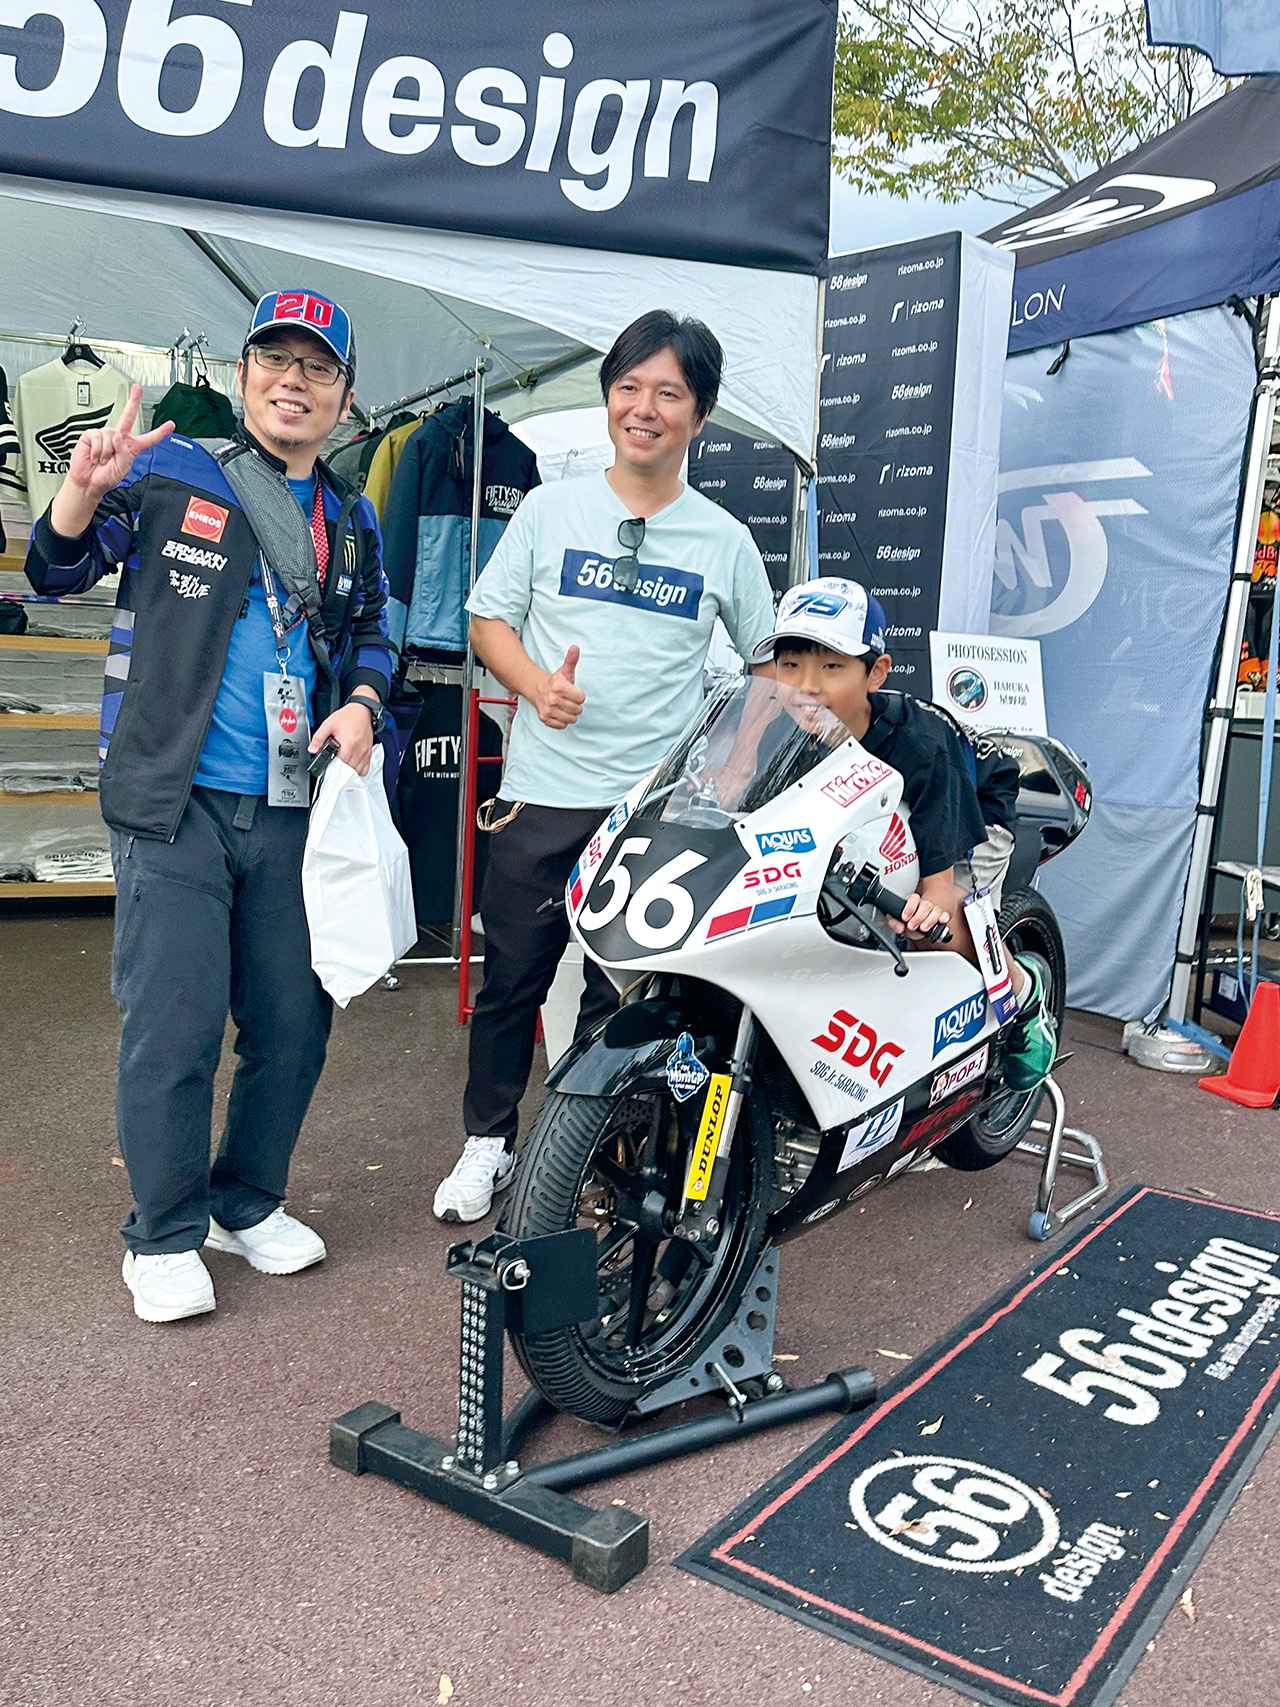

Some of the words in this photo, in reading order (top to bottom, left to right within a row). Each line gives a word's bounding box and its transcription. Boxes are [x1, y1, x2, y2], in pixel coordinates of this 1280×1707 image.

[898, 257, 944, 276] rizoma.co.jp
[830, 273, 868, 291] 56design
[274, 292, 333, 328] 20
[910, 298, 944, 316] rizoma
[824, 313, 867, 329] rizoma.co.jp
[891, 341, 938, 358] rizoma.co.jp
[836, 351, 867, 368] rizoma
[820, 393, 860, 407] rizoma.co.jp
[891, 383, 932, 401] 56design
[885, 423, 932, 439] rizoma.co.jp
[706, 441, 731, 453] rizoma
[820, 432, 856, 450] 56design
[896, 464, 933, 478] rizoma
[753, 476, 787, 491] 56design
[188, 511, 223, 530] ENEOS
[748, 514, 787, 525] rizoma.co.jp
[825, 511, 856, 523] rizoma
[878, 506, 927, 518] rizoma.co.jp
[762, 550, 787, 562] rizoma
[876, 545, 921, 560] 56design
[870, 586, 921, 598] rizoma.co.jp
[884, 626, 922, 637] rizoma
[947, 643, 1028, 664] PHOTOSESSION
[993, 681, 1030, 694] HARUKA
[760, 830, 812, 852] AQUAS
[743, 861, 802, 889] SDG
[577, 836, 709, 951] 56
[935, 993, 985, 1042] AQUAS
[809, 1009, 906, 1088] SDG
[810, 1060, 829, 1079] SDG
[699, 1083, 725, 1176] DUNLOP
[874, 1464, 1031, 1562] 56
[1038, 1520, 1126, 1603] design
